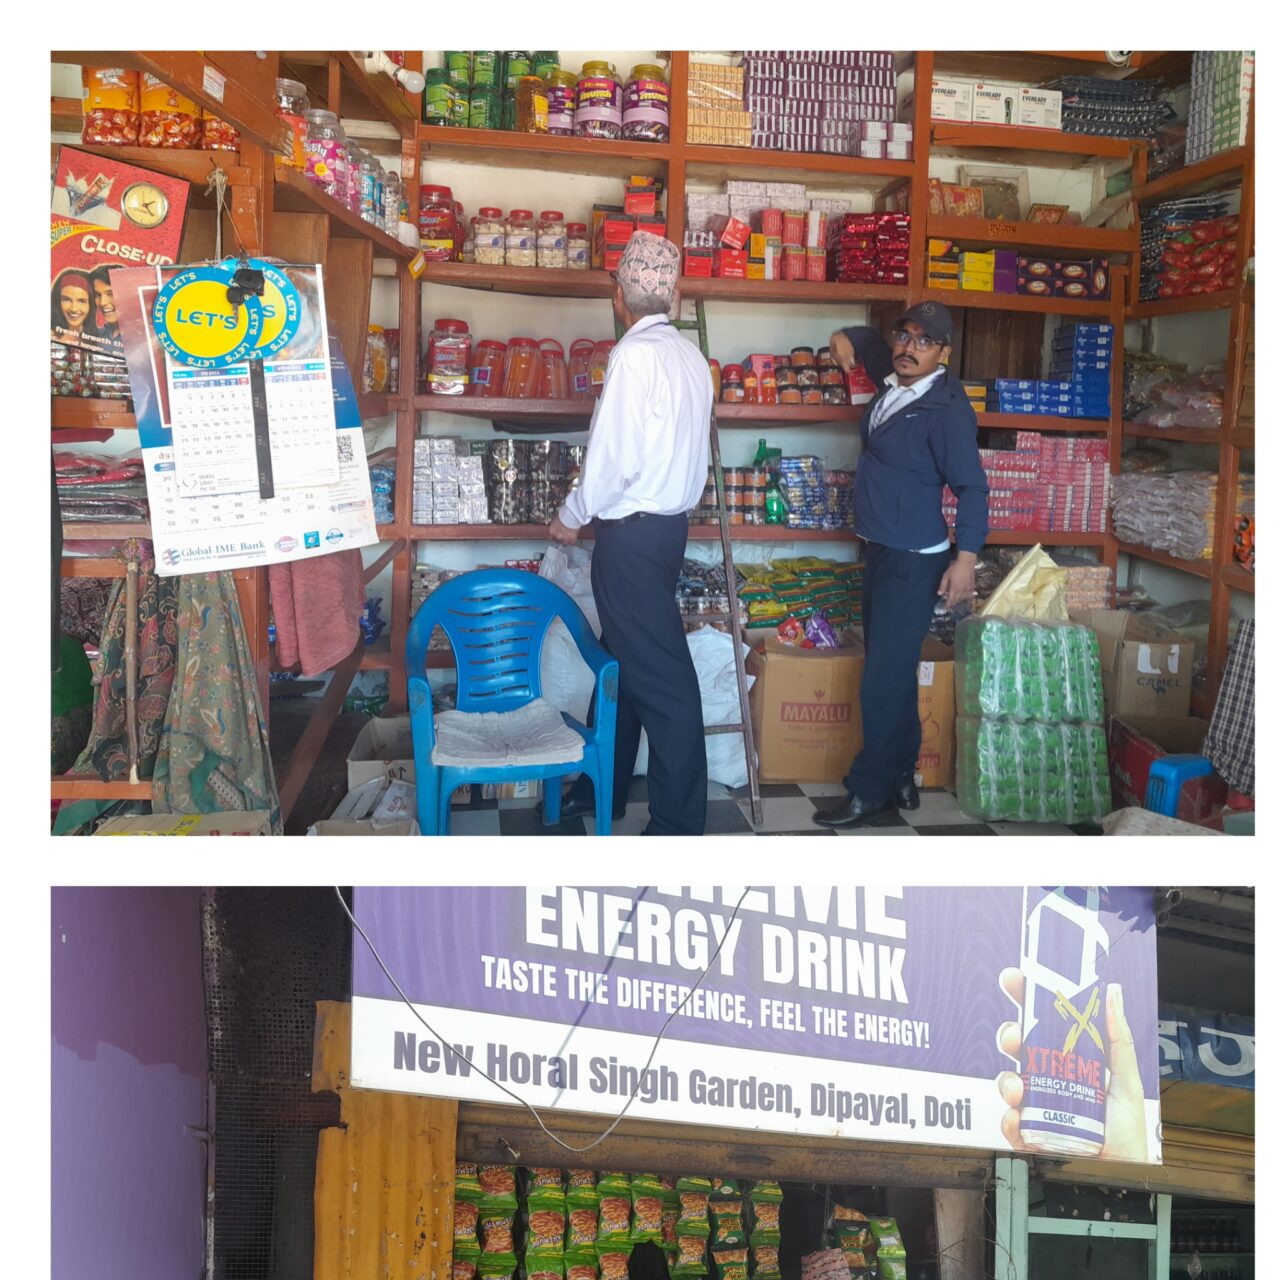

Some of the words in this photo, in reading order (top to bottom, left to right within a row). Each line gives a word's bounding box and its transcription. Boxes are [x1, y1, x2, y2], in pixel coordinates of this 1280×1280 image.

[169, 271, 197, 291] LET'S
[261, 267, 287, 288] LET'S
[154, 295, 168, 323] LET'S
[286, 293, 298, 322] LET'S
[176, 308, 238, 330] LET'S
[249, 308, 259, 336] LET'S
[55, 326, 80, 338] fresh
[81, 332, 112, 346] breath
[158, 332, 180, 357] LET'S
[270, 329, 293, 352] LET'S
[187, 356, 216, 368] LET'S
[224, 341, 250, 363] LET'S
[181, 544, 213, 557] Global
[216, 542, 237, 553] IME
[240, 540, 266, 550] Bank
[1137, 677, 1181, 688] CAMEL
[782, 705, 849, 722] MAYALU
[526, 886, 742, 976] ENERGY
[762, 924, 909, 1004] DRINK
[481, 955, 558, 998] TASTE
[565, 968, 609, 1005] THE
[617, 976, 752, 1029] DIFFERENCE,
[760, 999, 806, 1032] FEEL
[812, 1005, 849, 1038] THE
[854, 1012, 930, 1049] ENERGY!
[1026, 1046, 1100, 1087] XTREME
[393, 1031, 475, 1078] New
[486, 1042, 578, 1091] Horal
[589, 1056, 679, 1104] Singh
[689, 1069, 800, 1118] Garden,
[810, 1082, 916, 1129] Dipayal,
[924, 1094, 972, 1131] Doti
[1030, 1076, 1067, 1089] ENERGY
[1069, 1082, 1096, 1099] DRINK
[1043, 1110, 1076, 1125] CLASSIC
